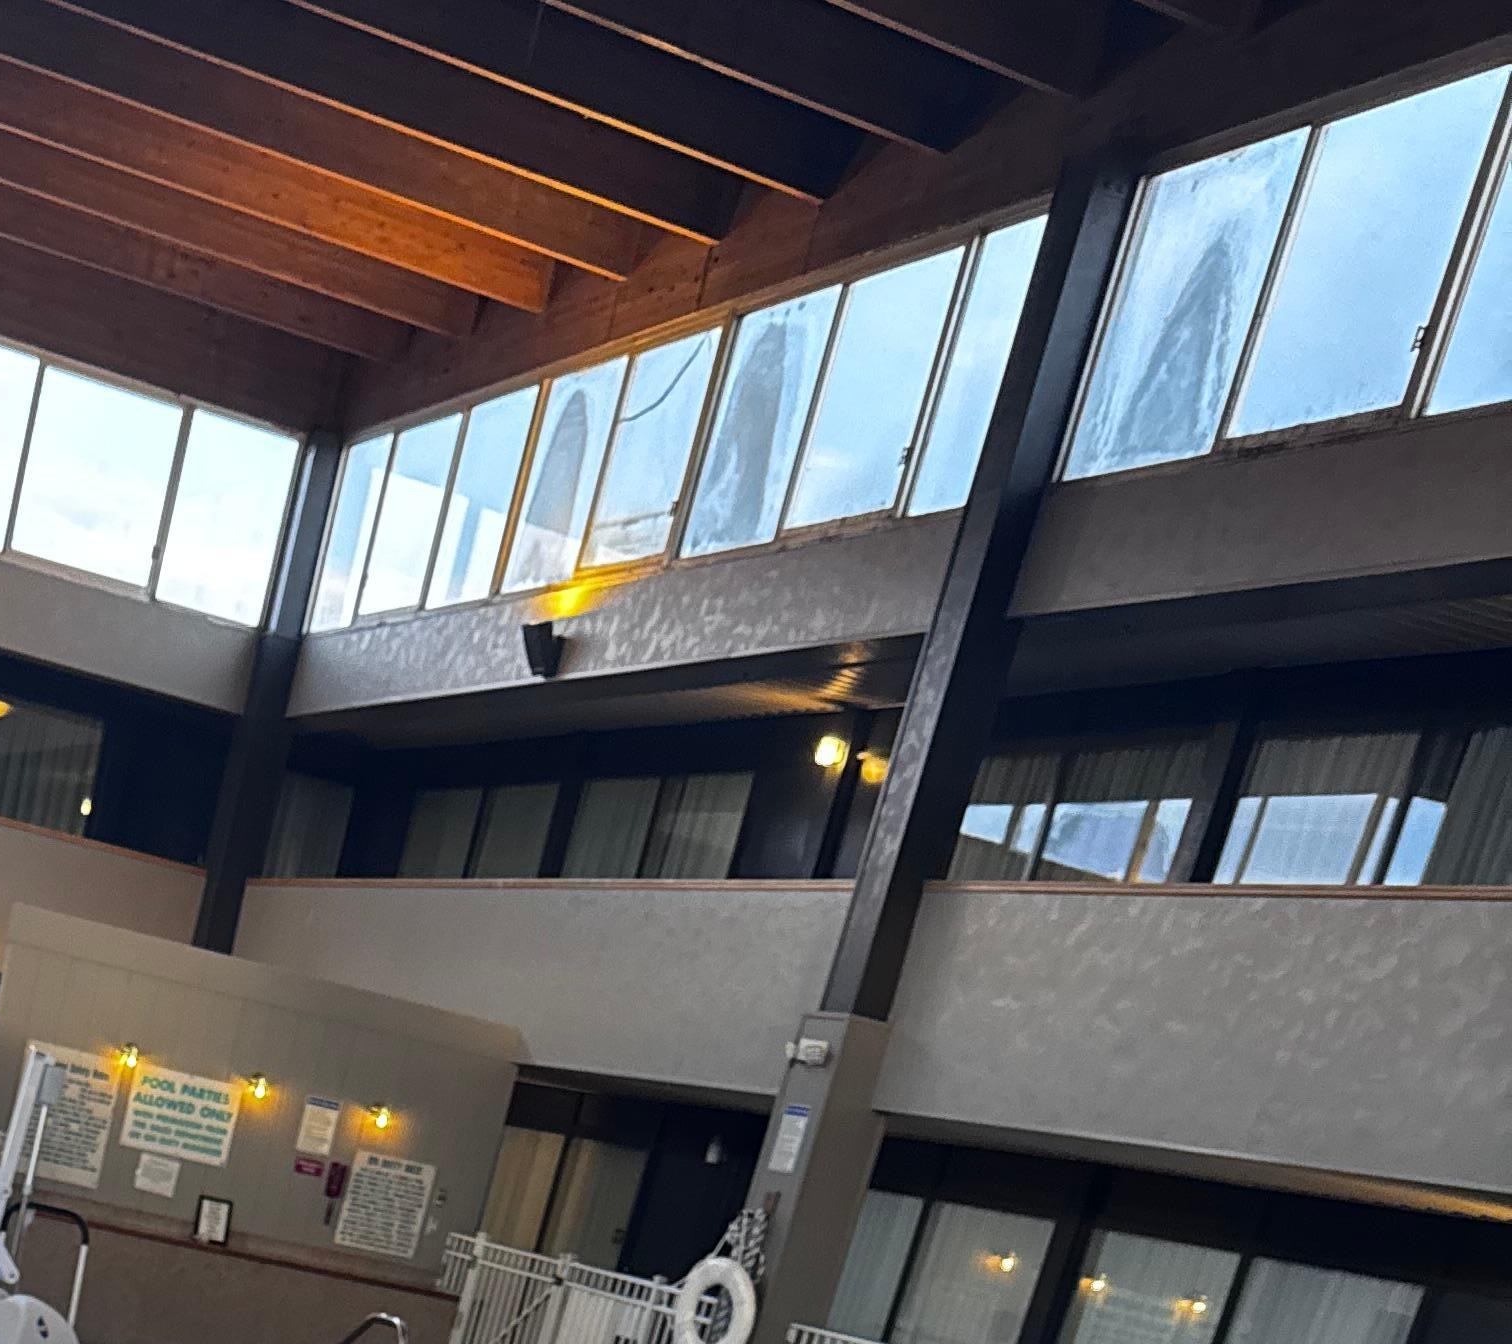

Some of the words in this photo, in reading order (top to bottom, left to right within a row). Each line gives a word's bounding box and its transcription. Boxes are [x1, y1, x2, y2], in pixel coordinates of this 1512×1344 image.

[141, 1076, 175, 1094] POOL
[180, 1084, 230, 1105] PARTIES
[133, 1092, 195, 1115] ALLOWED
[199, 1106, 234, 1123] ONLY
